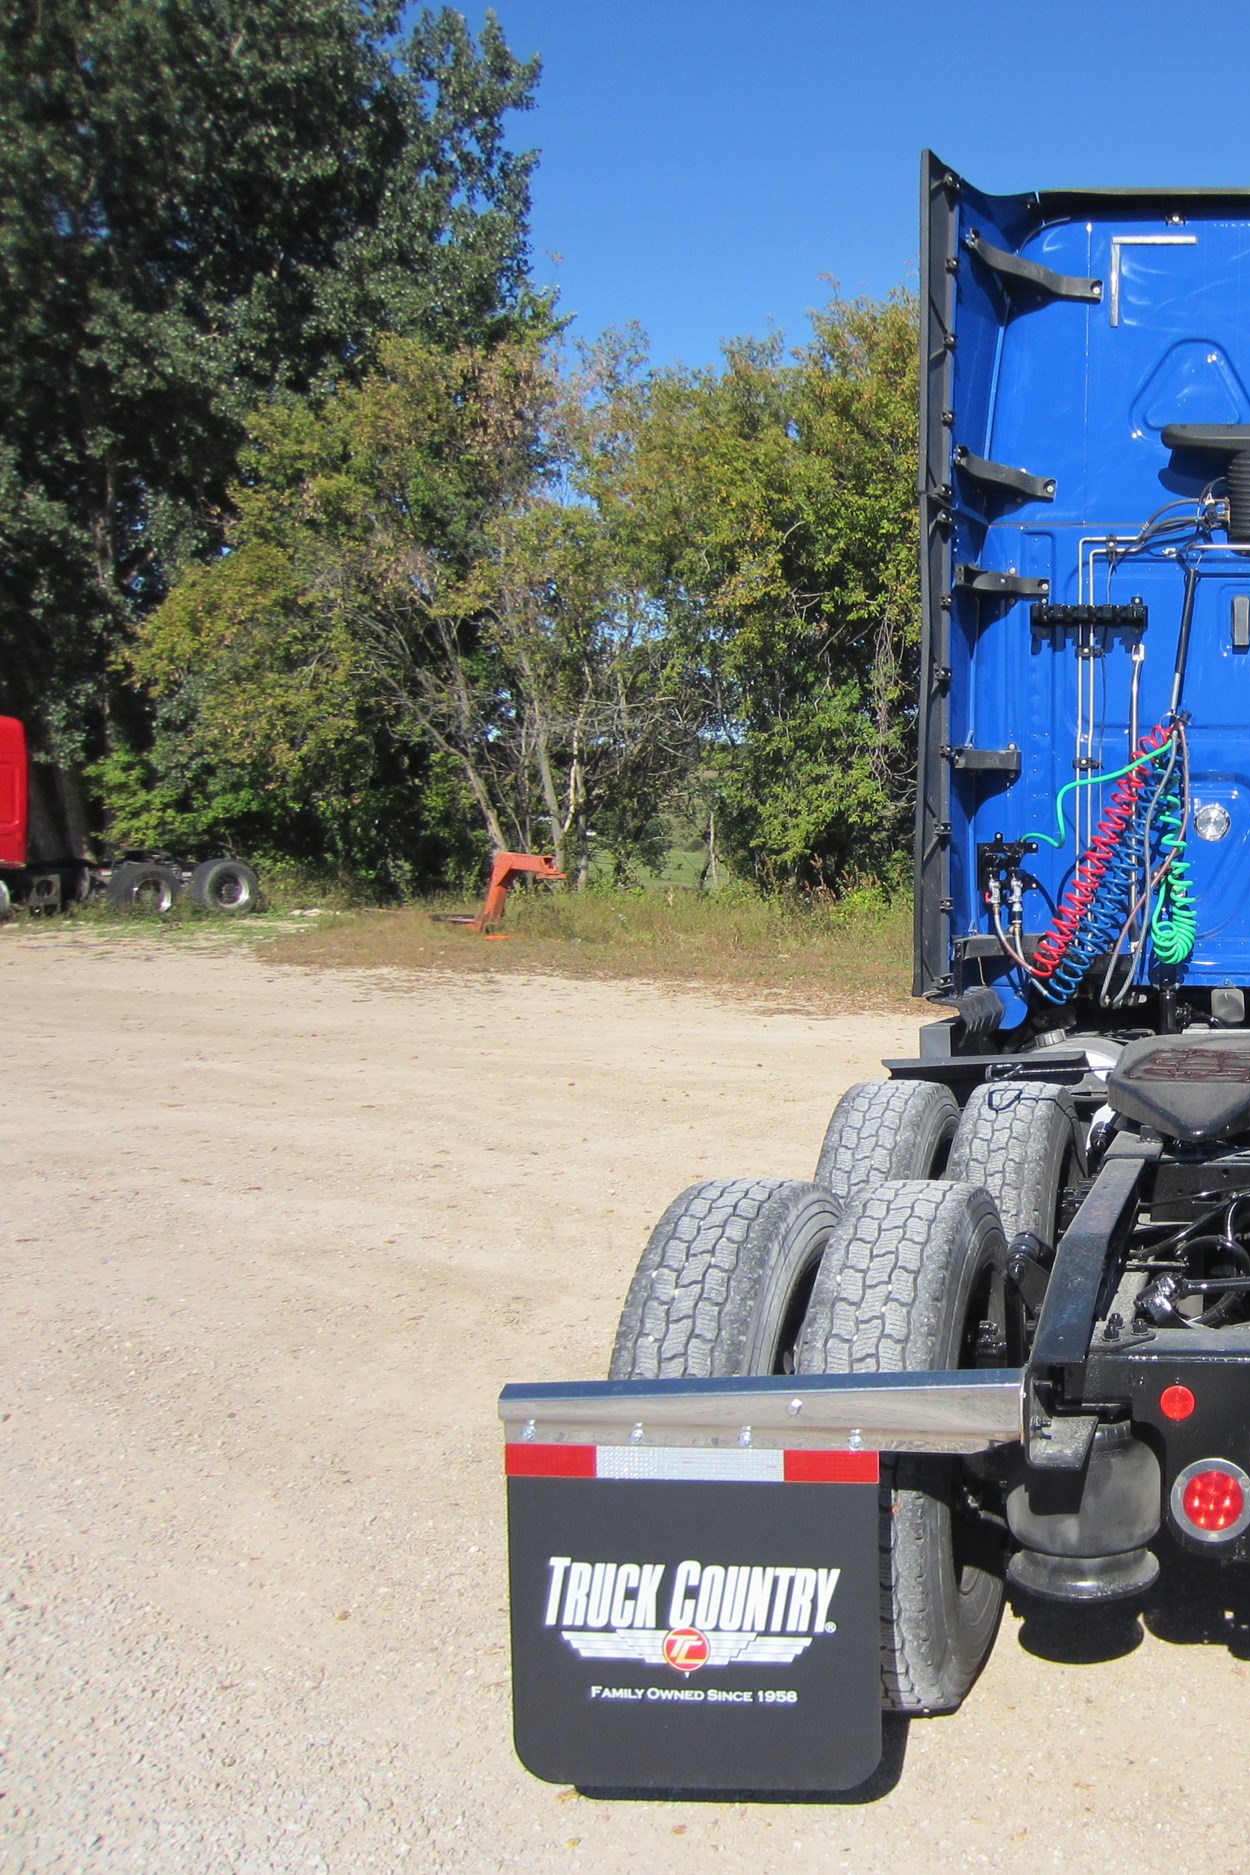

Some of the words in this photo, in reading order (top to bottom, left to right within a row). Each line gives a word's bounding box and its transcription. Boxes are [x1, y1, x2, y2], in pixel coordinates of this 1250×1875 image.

[545, 1556, 665, 1628] TRUCK
[591, 1686, 645, 1699] FAMILY
[646, 1687, 705, 1701] OWNED
[706, 1689, 753, 1702] SINCE
[757, 1690, 798, 1703] 1958
